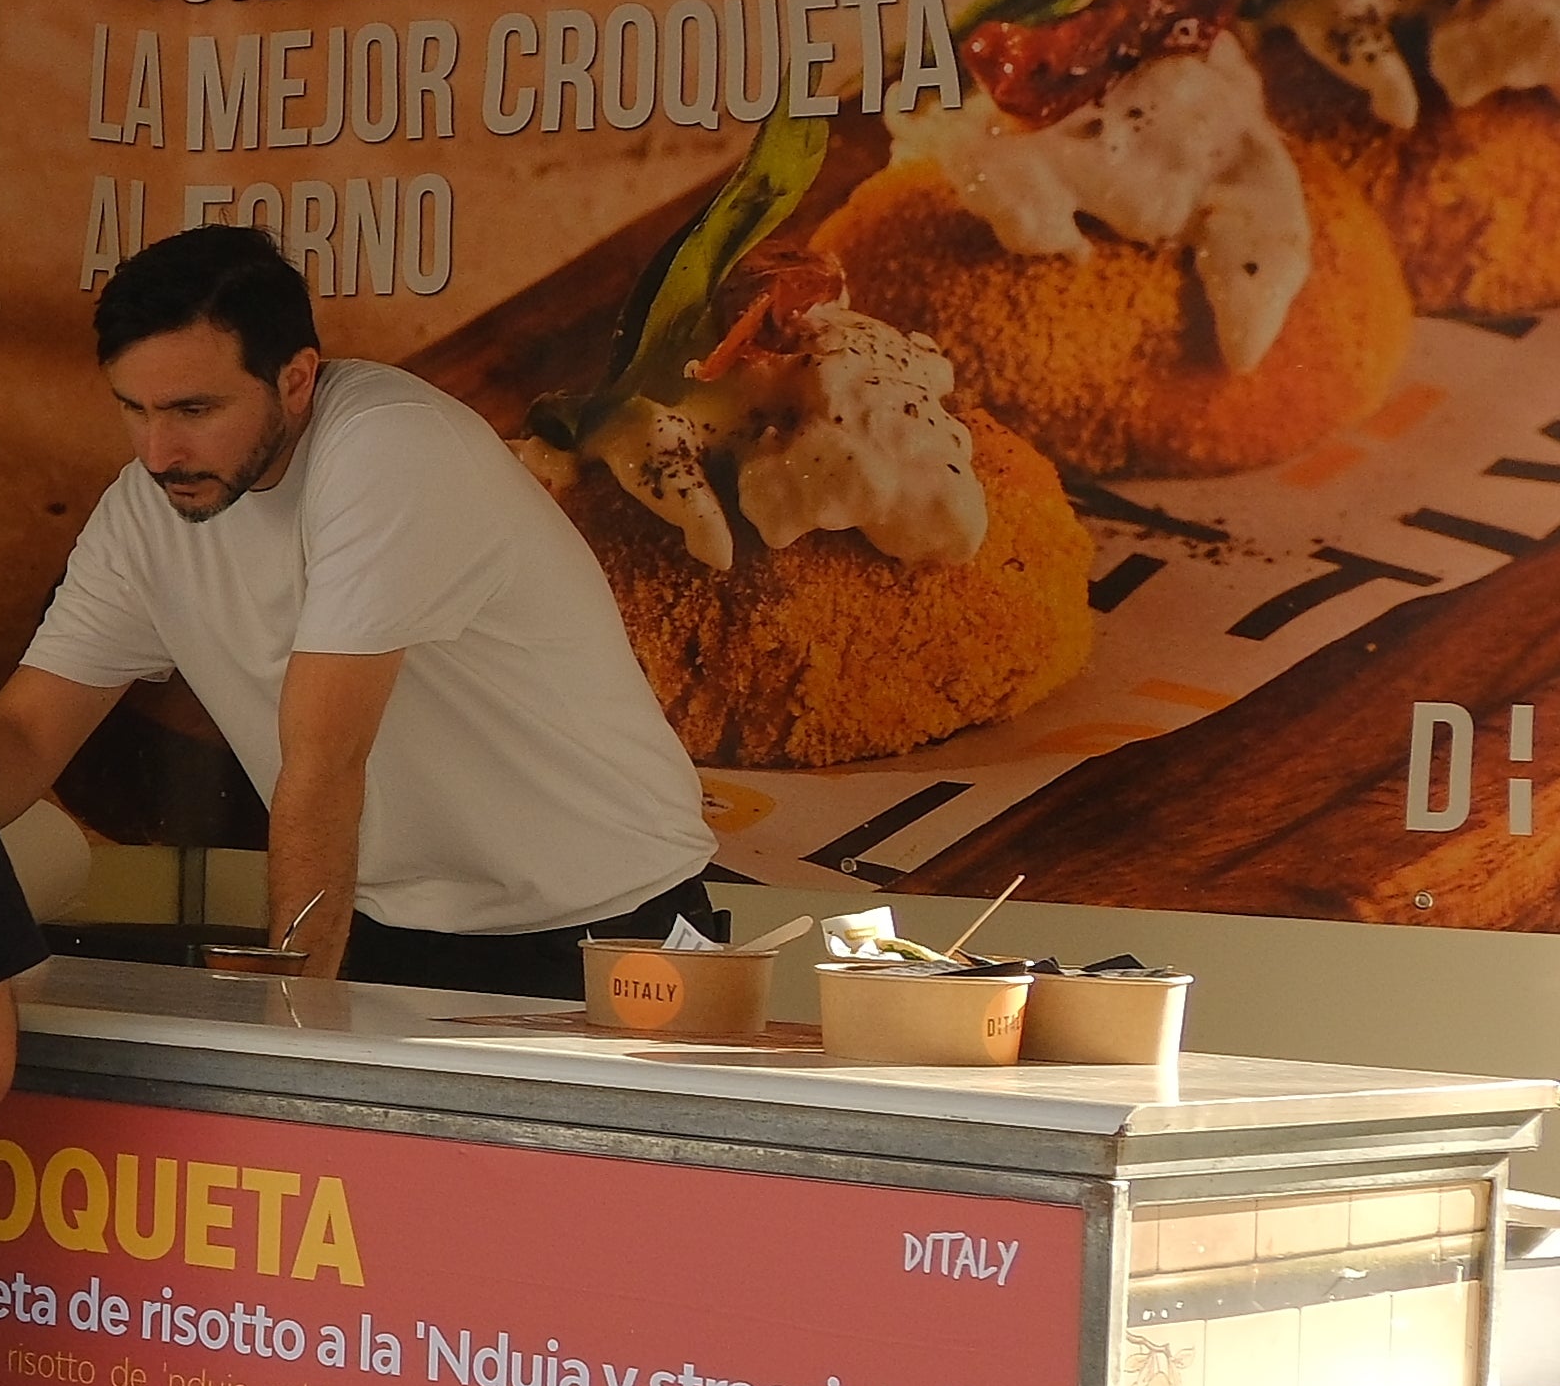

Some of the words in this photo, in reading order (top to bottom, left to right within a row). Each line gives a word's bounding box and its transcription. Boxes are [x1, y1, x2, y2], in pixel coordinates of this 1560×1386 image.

[87, 22, 165, 149] LA
[185, 19, 459, 153] MEJOR
[614, 978, 678, 1002] DITALY
[903, 1231, 1019, 1286] DITALY
[69, 1277, 129, 1336] de
[141, 1287, 306, 1361] risotto
[317, 1325, 345, 1368] a
[360, 1314, 401, 1376] la
[8, 1343, 95, 1384] risotto
